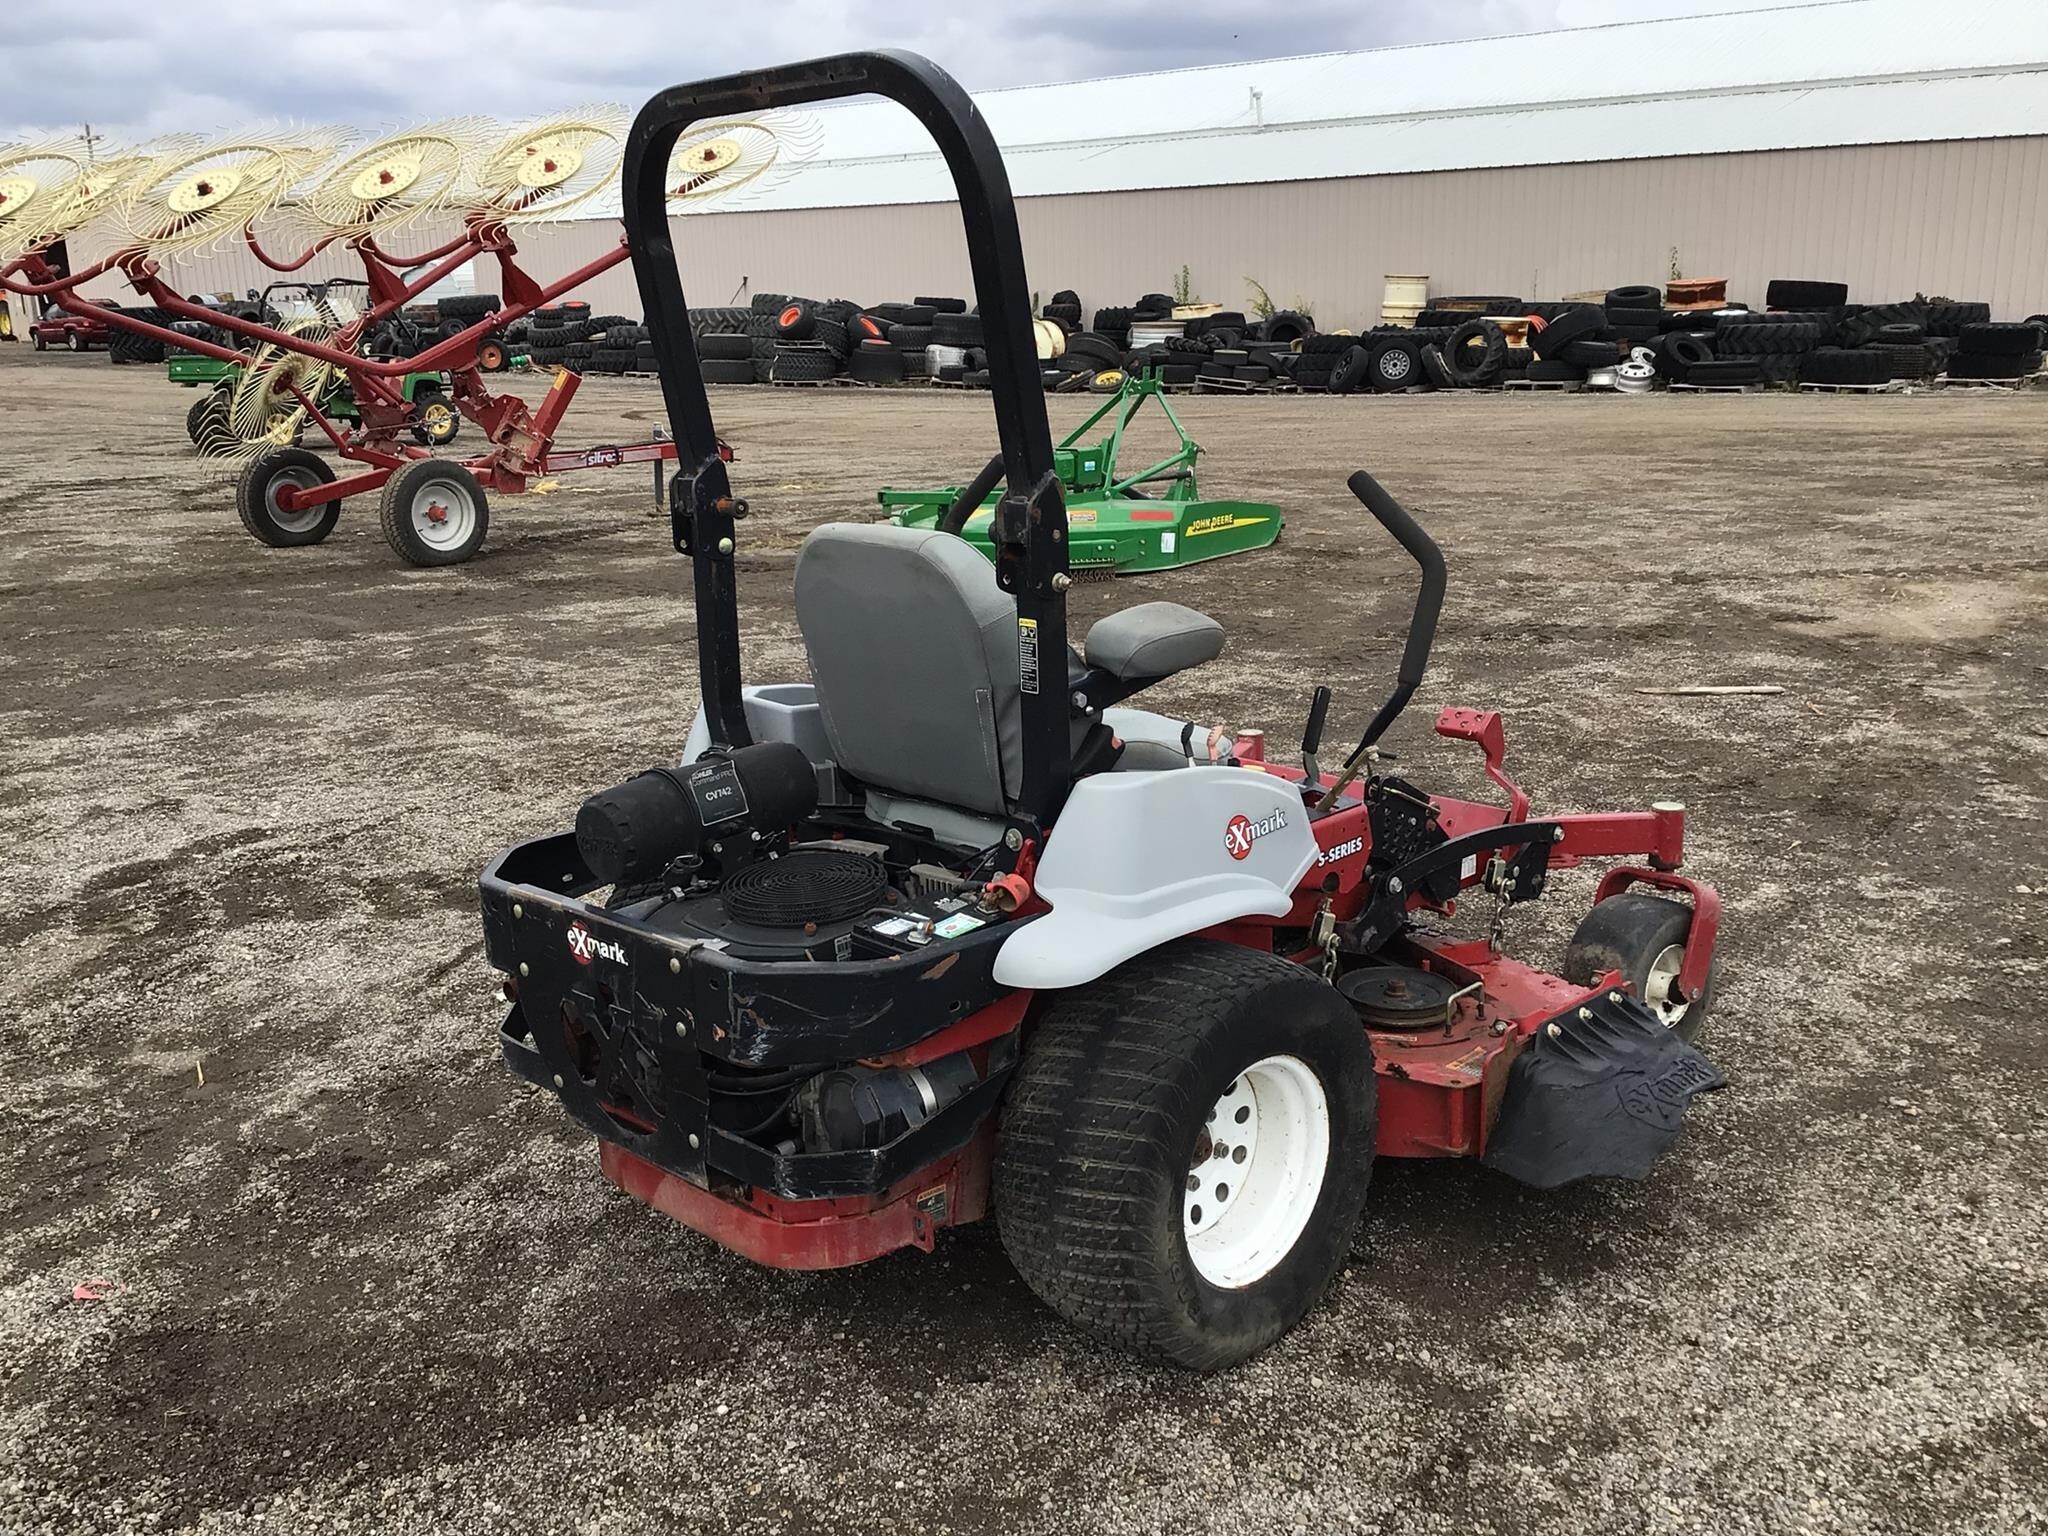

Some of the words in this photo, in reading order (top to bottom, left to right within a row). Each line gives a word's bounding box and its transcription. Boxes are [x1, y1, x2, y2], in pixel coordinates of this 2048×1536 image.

[1192, 518, 1211, 531] JOHN
[1211, 513, 1234, 529] DEERE
[705, 786, 732, 801] CV742
[1225, 808, 1288, 856] eXmark
[1318, 836, 1363, 867] S-SERIES
